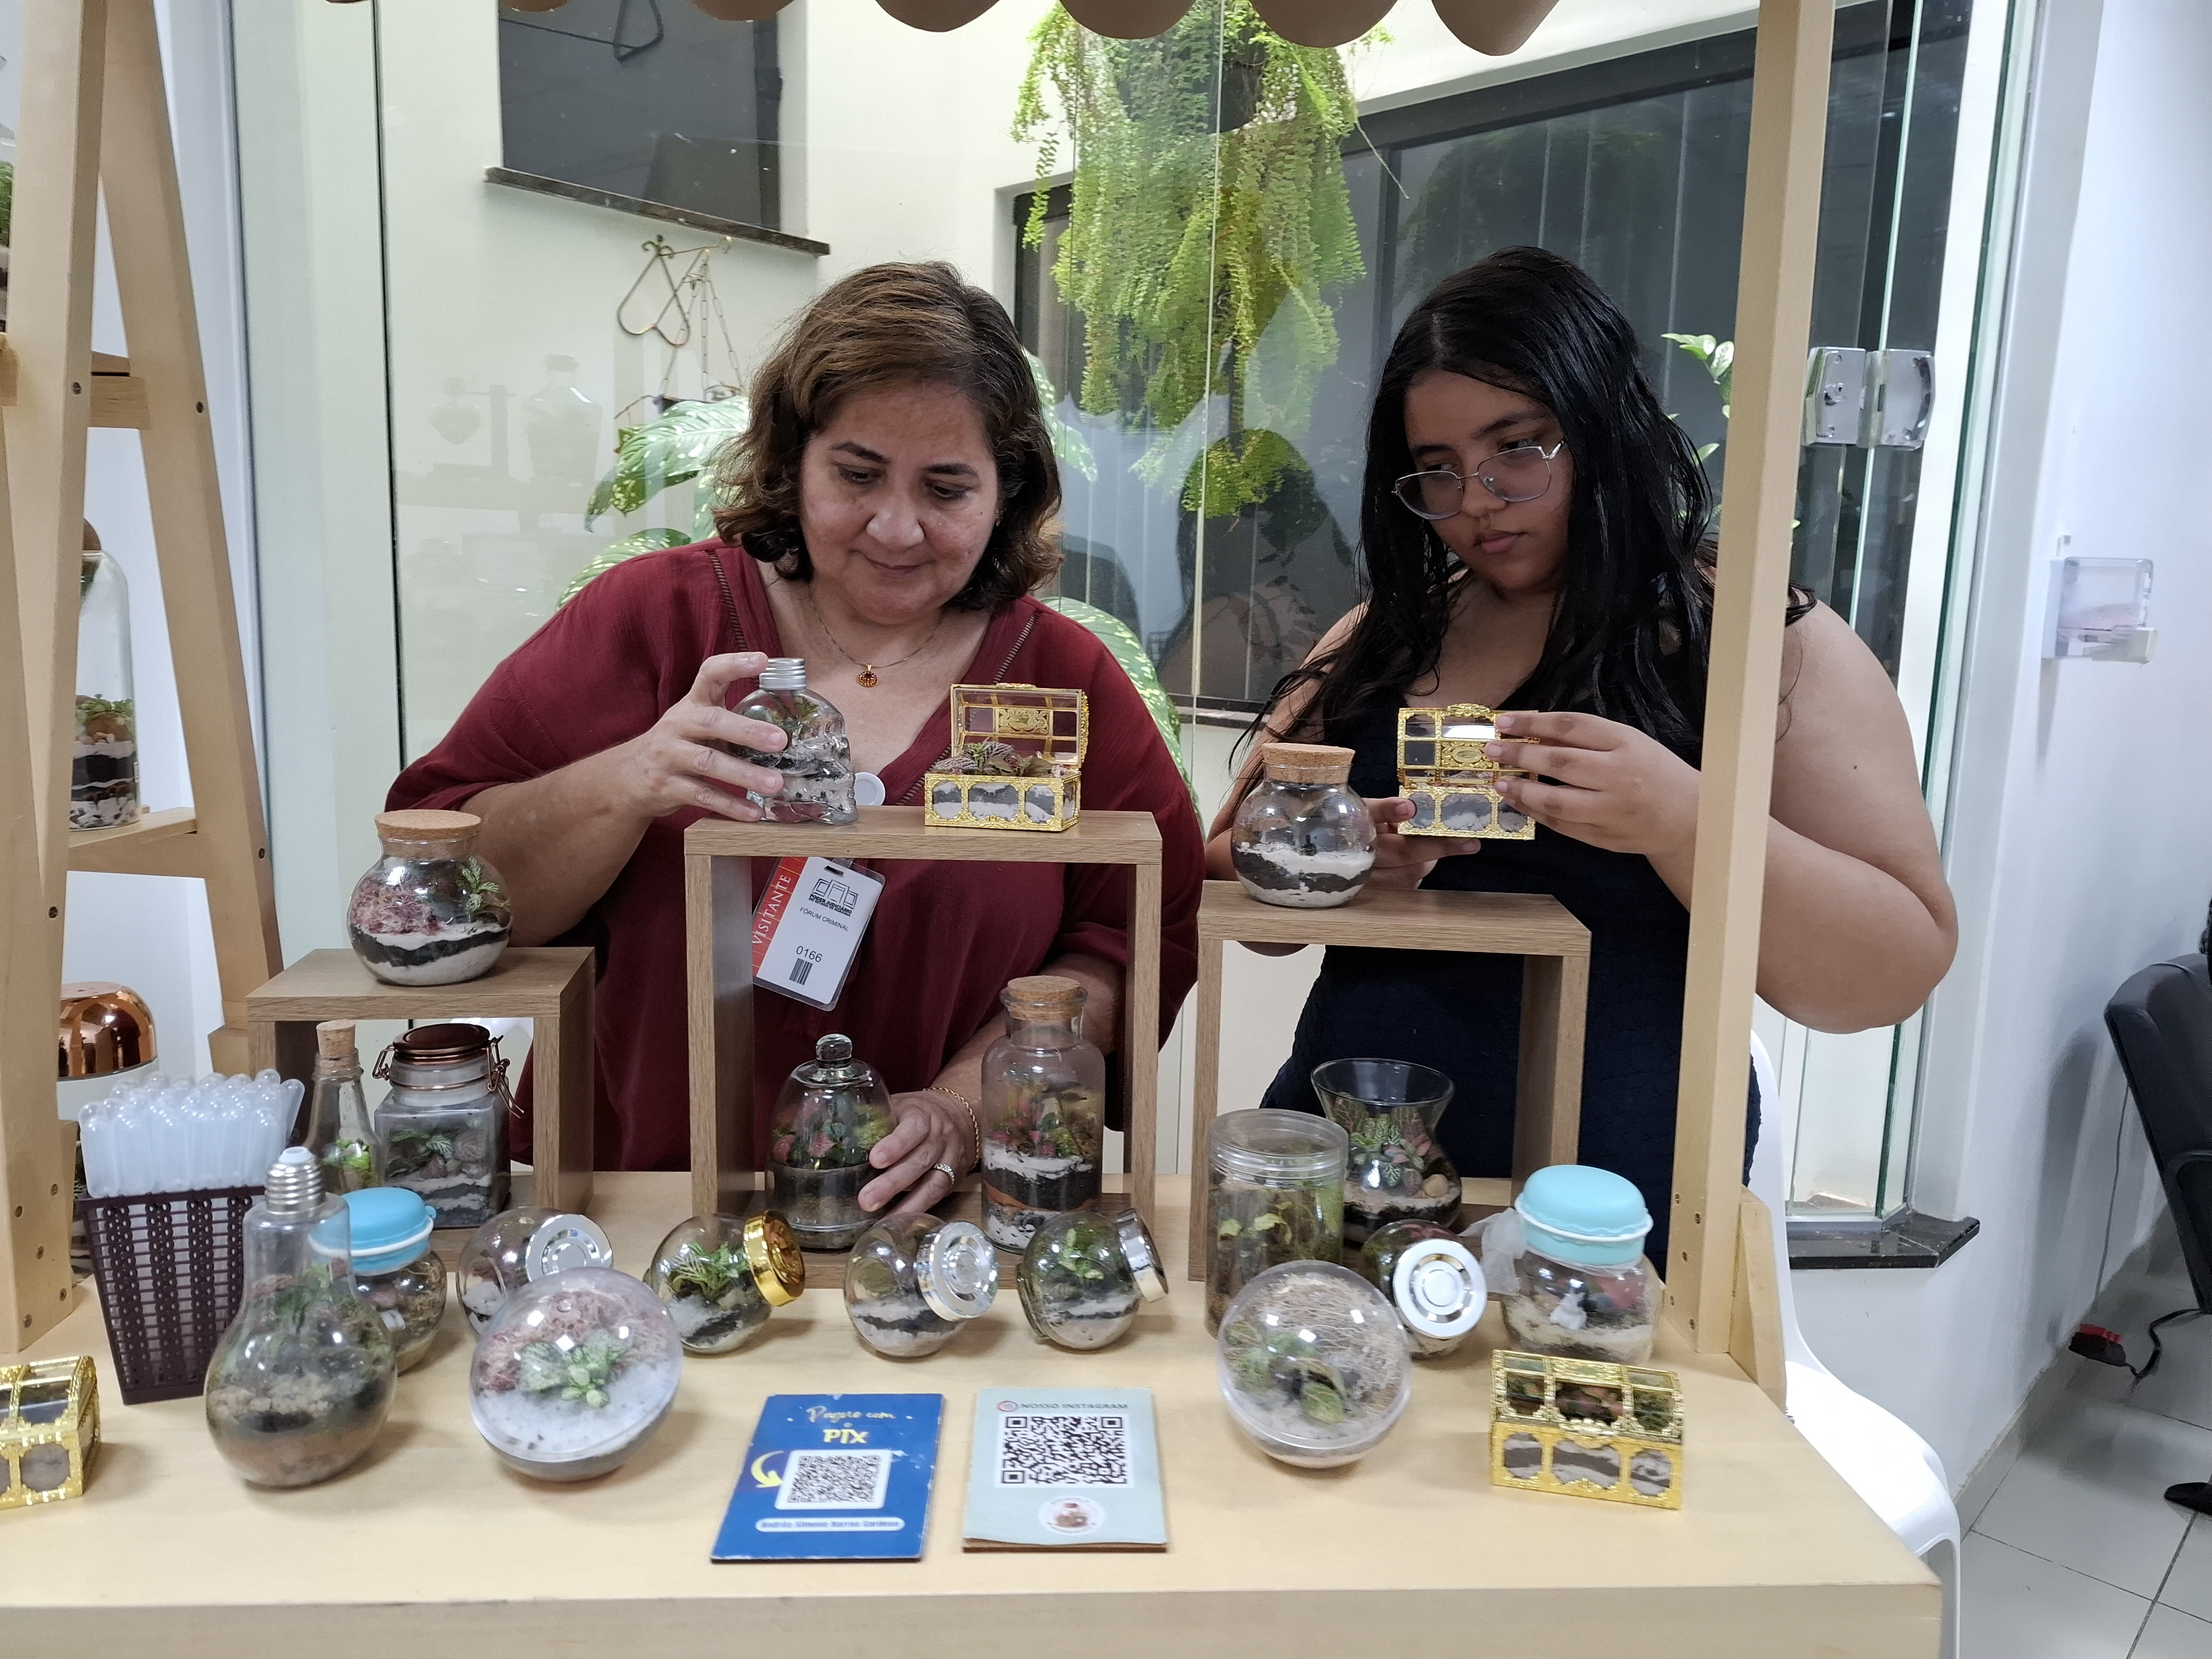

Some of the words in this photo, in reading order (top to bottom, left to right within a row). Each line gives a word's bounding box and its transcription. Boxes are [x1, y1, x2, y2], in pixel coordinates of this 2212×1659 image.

[752, 874, 791, 944] VISITANTE
[800, 907, 821, 920] FÓRUM
[822, 916, 848, 931] CRIMINAL
[796, 946, 823, 962] 0166
[806, 1405, 862, 1423] Pague
